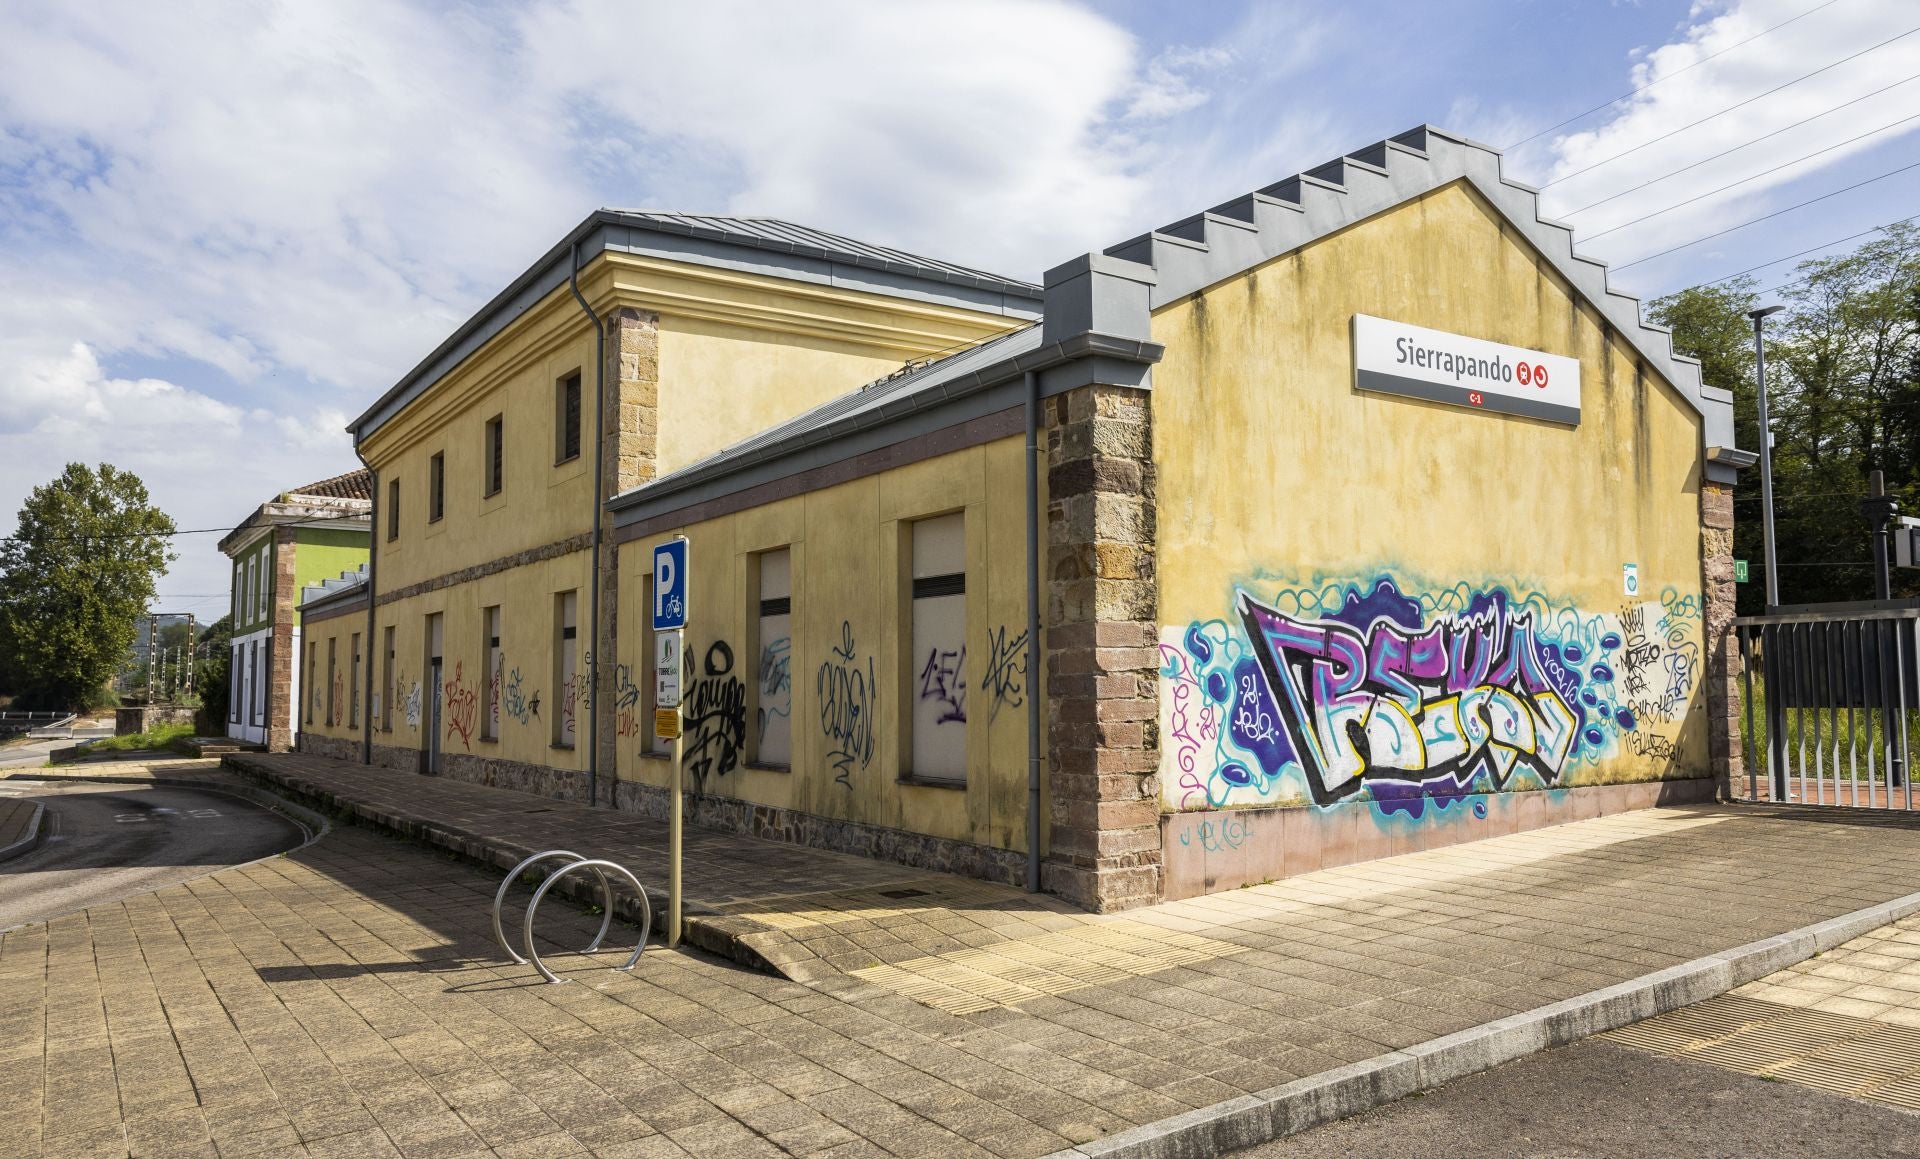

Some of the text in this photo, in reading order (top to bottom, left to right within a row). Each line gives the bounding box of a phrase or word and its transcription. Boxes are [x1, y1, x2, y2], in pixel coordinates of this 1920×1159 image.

[1396, 337, 1512, 383] Sierrapando
[1469, 393, 1482, 404] C-1
[656, 551, 675, 617] P
